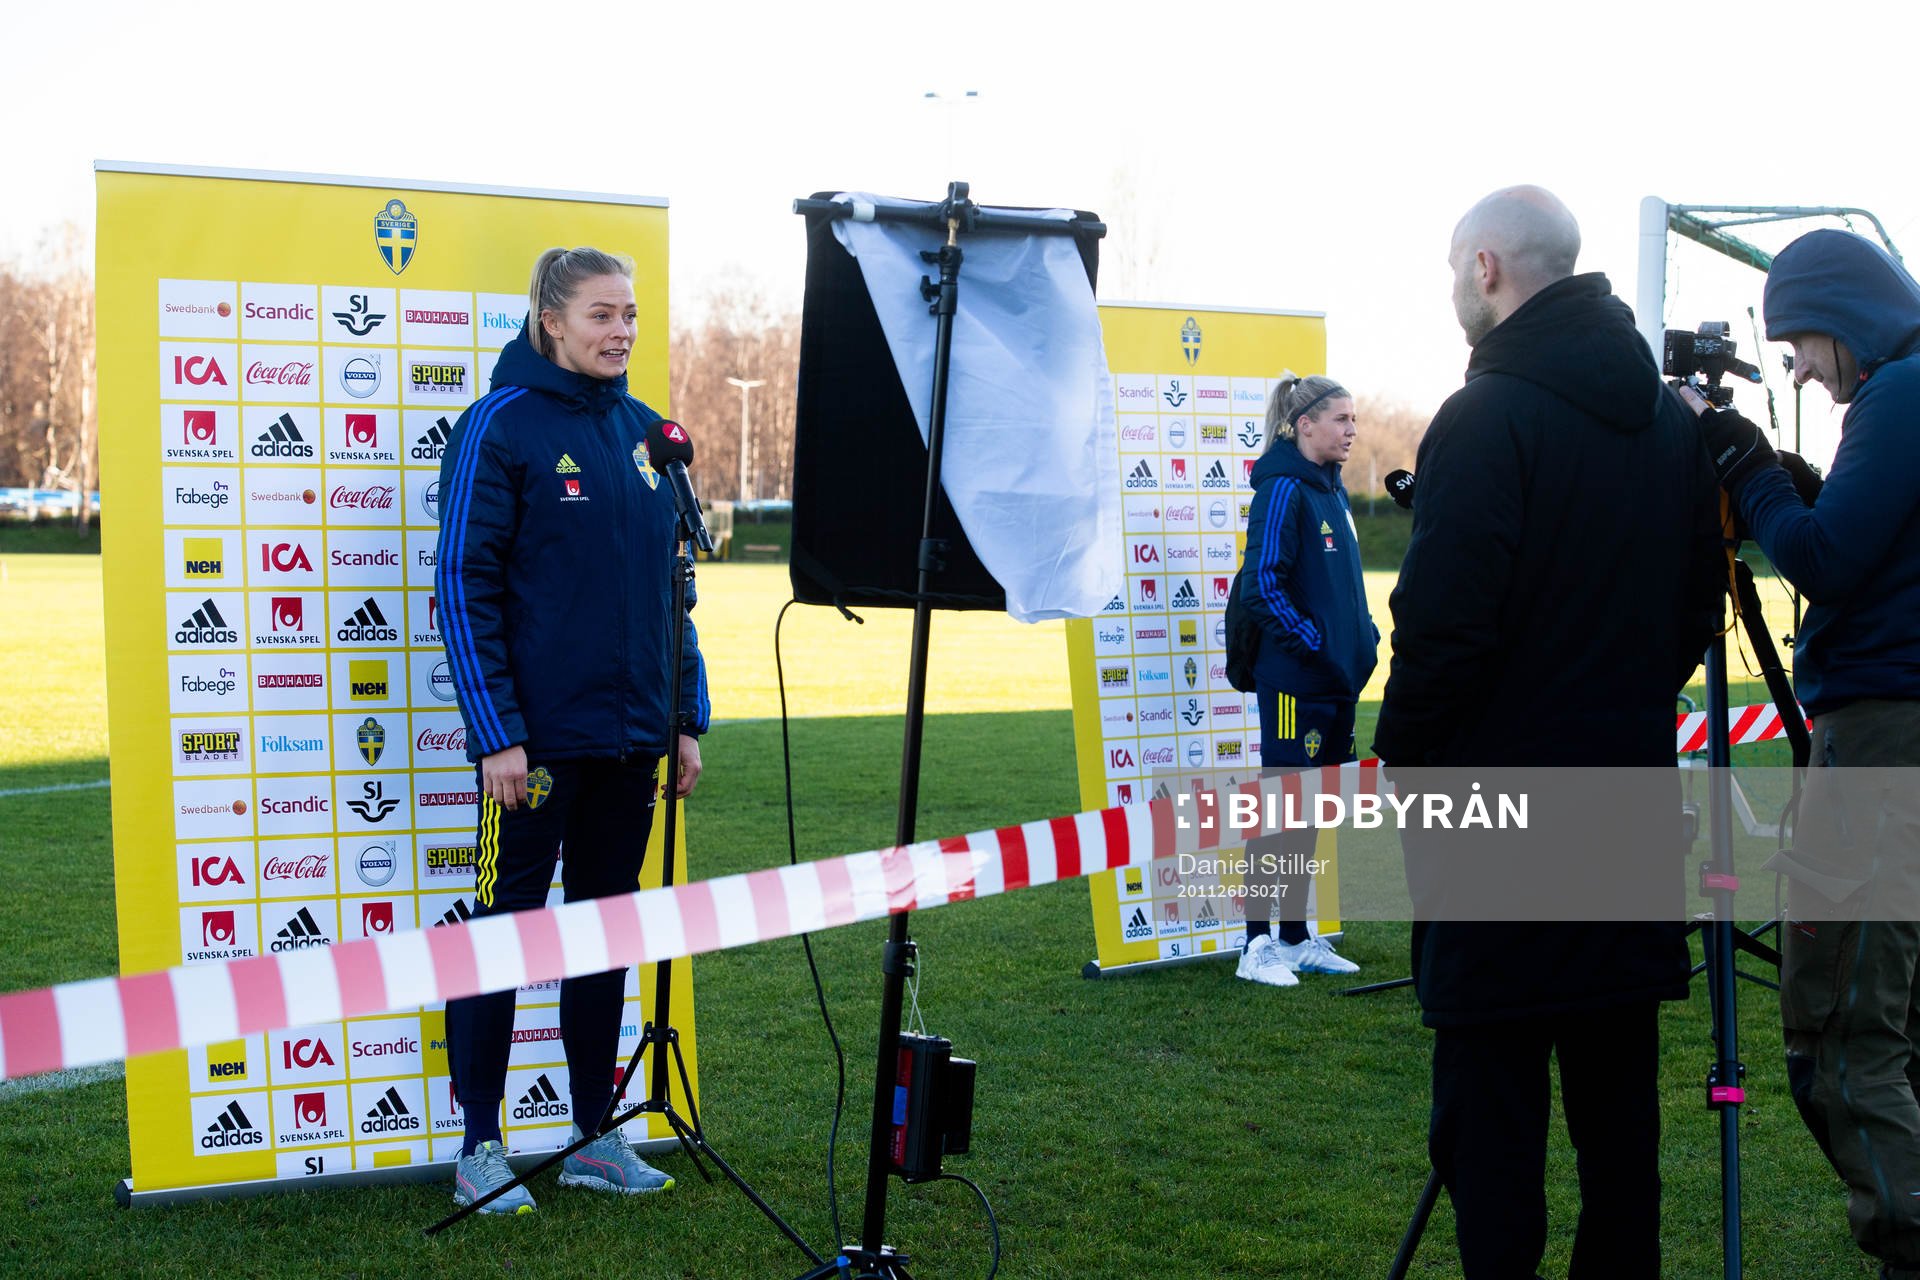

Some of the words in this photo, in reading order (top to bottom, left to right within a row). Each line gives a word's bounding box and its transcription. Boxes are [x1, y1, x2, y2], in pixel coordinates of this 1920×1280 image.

[380, 221, 412, 229] SVERIGE
[165, 302, 216, 314] Swedbank
[349, 294, 368, 314] SJ
[245, 302, 314, 321] Scandic
[406, 310, 469, 325] BAUHAUS
[483, 311, 526, 330] Folks
[174, 355, 228, 386] ICA
[246, 361, 314, 386] Coca-Cola
[345, 372, 375, 380] VOLVO
[412, 364, 465, 385] SPORT
[414, 385, 464, 393] BLADET
[1120, 387, 1155, 399] Scandic
[1170, 380, 1179, 392] SJ
[669, 425, 684, 441] 4
[1245, 422, 1254, 434] SJ
[167, 448, 210, 458] SVENSKA
[213, 449, 234, 458] SPEL
[251, 441, 313, 457] adidas
[330, 451, 371, 461] SVENSKA
[373, 452, 395, 461] SPEL
[1126, 477, 1158, 488] adidas
[1202, 478, 1230, 488] adidas
[176, 488, 228, 508] Fabege
[251, 491, 301, 502] Swedbank
[330, 485, 395, 509] Coca-Cola
[262, 543, 313, 572] ICA
[331, 550, 399, 566] Scandic
[1134, 544, 1159, 563] ICA
[1168, 547, 1198, 558] Scandic
[1208, 548, 1232, 560] Fabege
[1172, 598, 1200, 608] adidas
[175, 627, 238, 644] adidas
[256, 635, 297, 644] SVENSKA
[300, 635, 320, 644] SPEL
[337, 626, 397, 642] adidas
[414, 634, 441, 642] SVENS
[1099, 631, 1125, 645] Fabege
[1136, 629, 1167, 639] BAUHAUS
[258, 674, 322, 688] BAUHAUS
[1102, 668, 1128, 682] SPORT
[1138, 669, 1169, 681] Folksam
[182, 675, 235, 695] Fabege
[1189, 699, 1197, 712] SJ
[1140, 708, 1172, 722] Scandic
[181, 733, 240, 753] SPORT
[261, 735, 323, 752] Folksam
[185, 753, 239, 761] BLADET
[1110, 749, 1134, 768] ICA
[364, 781, 382, 800] SJ
[181, 804, 231, 814] Swedbank
[261, 796, 328, 814] Scandic
[263, 855, 330, 880] Coca-Cola
[361, 859, 391, 868] VOLVO
[192, 856, 245, 887] ICA
[1125, 925, 1152, 938] adidas
[187, 951, 229, 961] SVENSKA
[232, 949, 254, 959] SPEL
[1171, 944, 1180, 956] SJ
[520, 982, 559, 990] LADET
[283, 1038, 335, 1070] ICA
[352, 1037, 418, 1057] Scandic
[513, 1101, 568, 1120] adidas
[361, 1114, 420, 1133] adidas
[435, 1119, 464, 1128] SVENS
[201, 1128, 263, 1148] adidas
[280, 1132, 321, 1143] SVENSKA
[324, 1130, 345, 1139] SPEL
[305, 1157, 324, 1175] SJ
